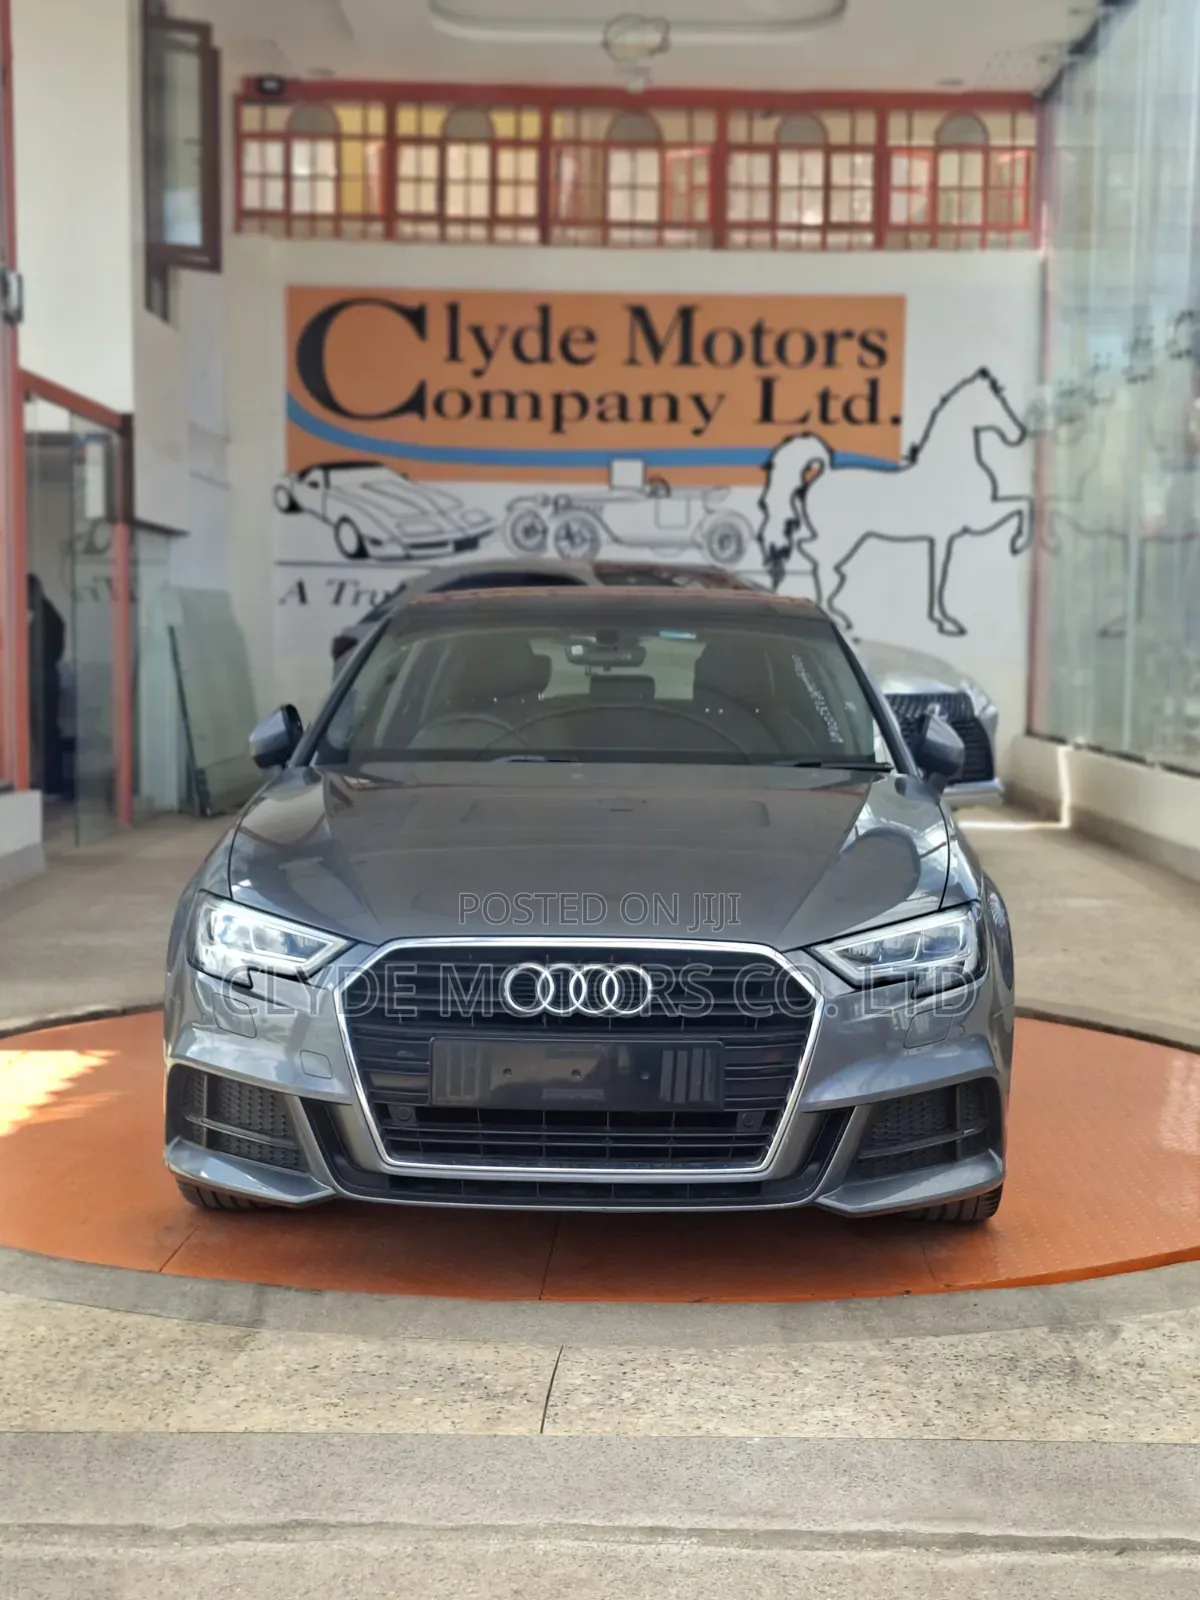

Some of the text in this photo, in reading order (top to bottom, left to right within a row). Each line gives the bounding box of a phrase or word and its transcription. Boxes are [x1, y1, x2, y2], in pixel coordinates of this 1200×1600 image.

[296, 297, 888, 421] Clyde Motors
[752, 374, 903, 426] Ltd.
[279, 579, 308, 606] A
